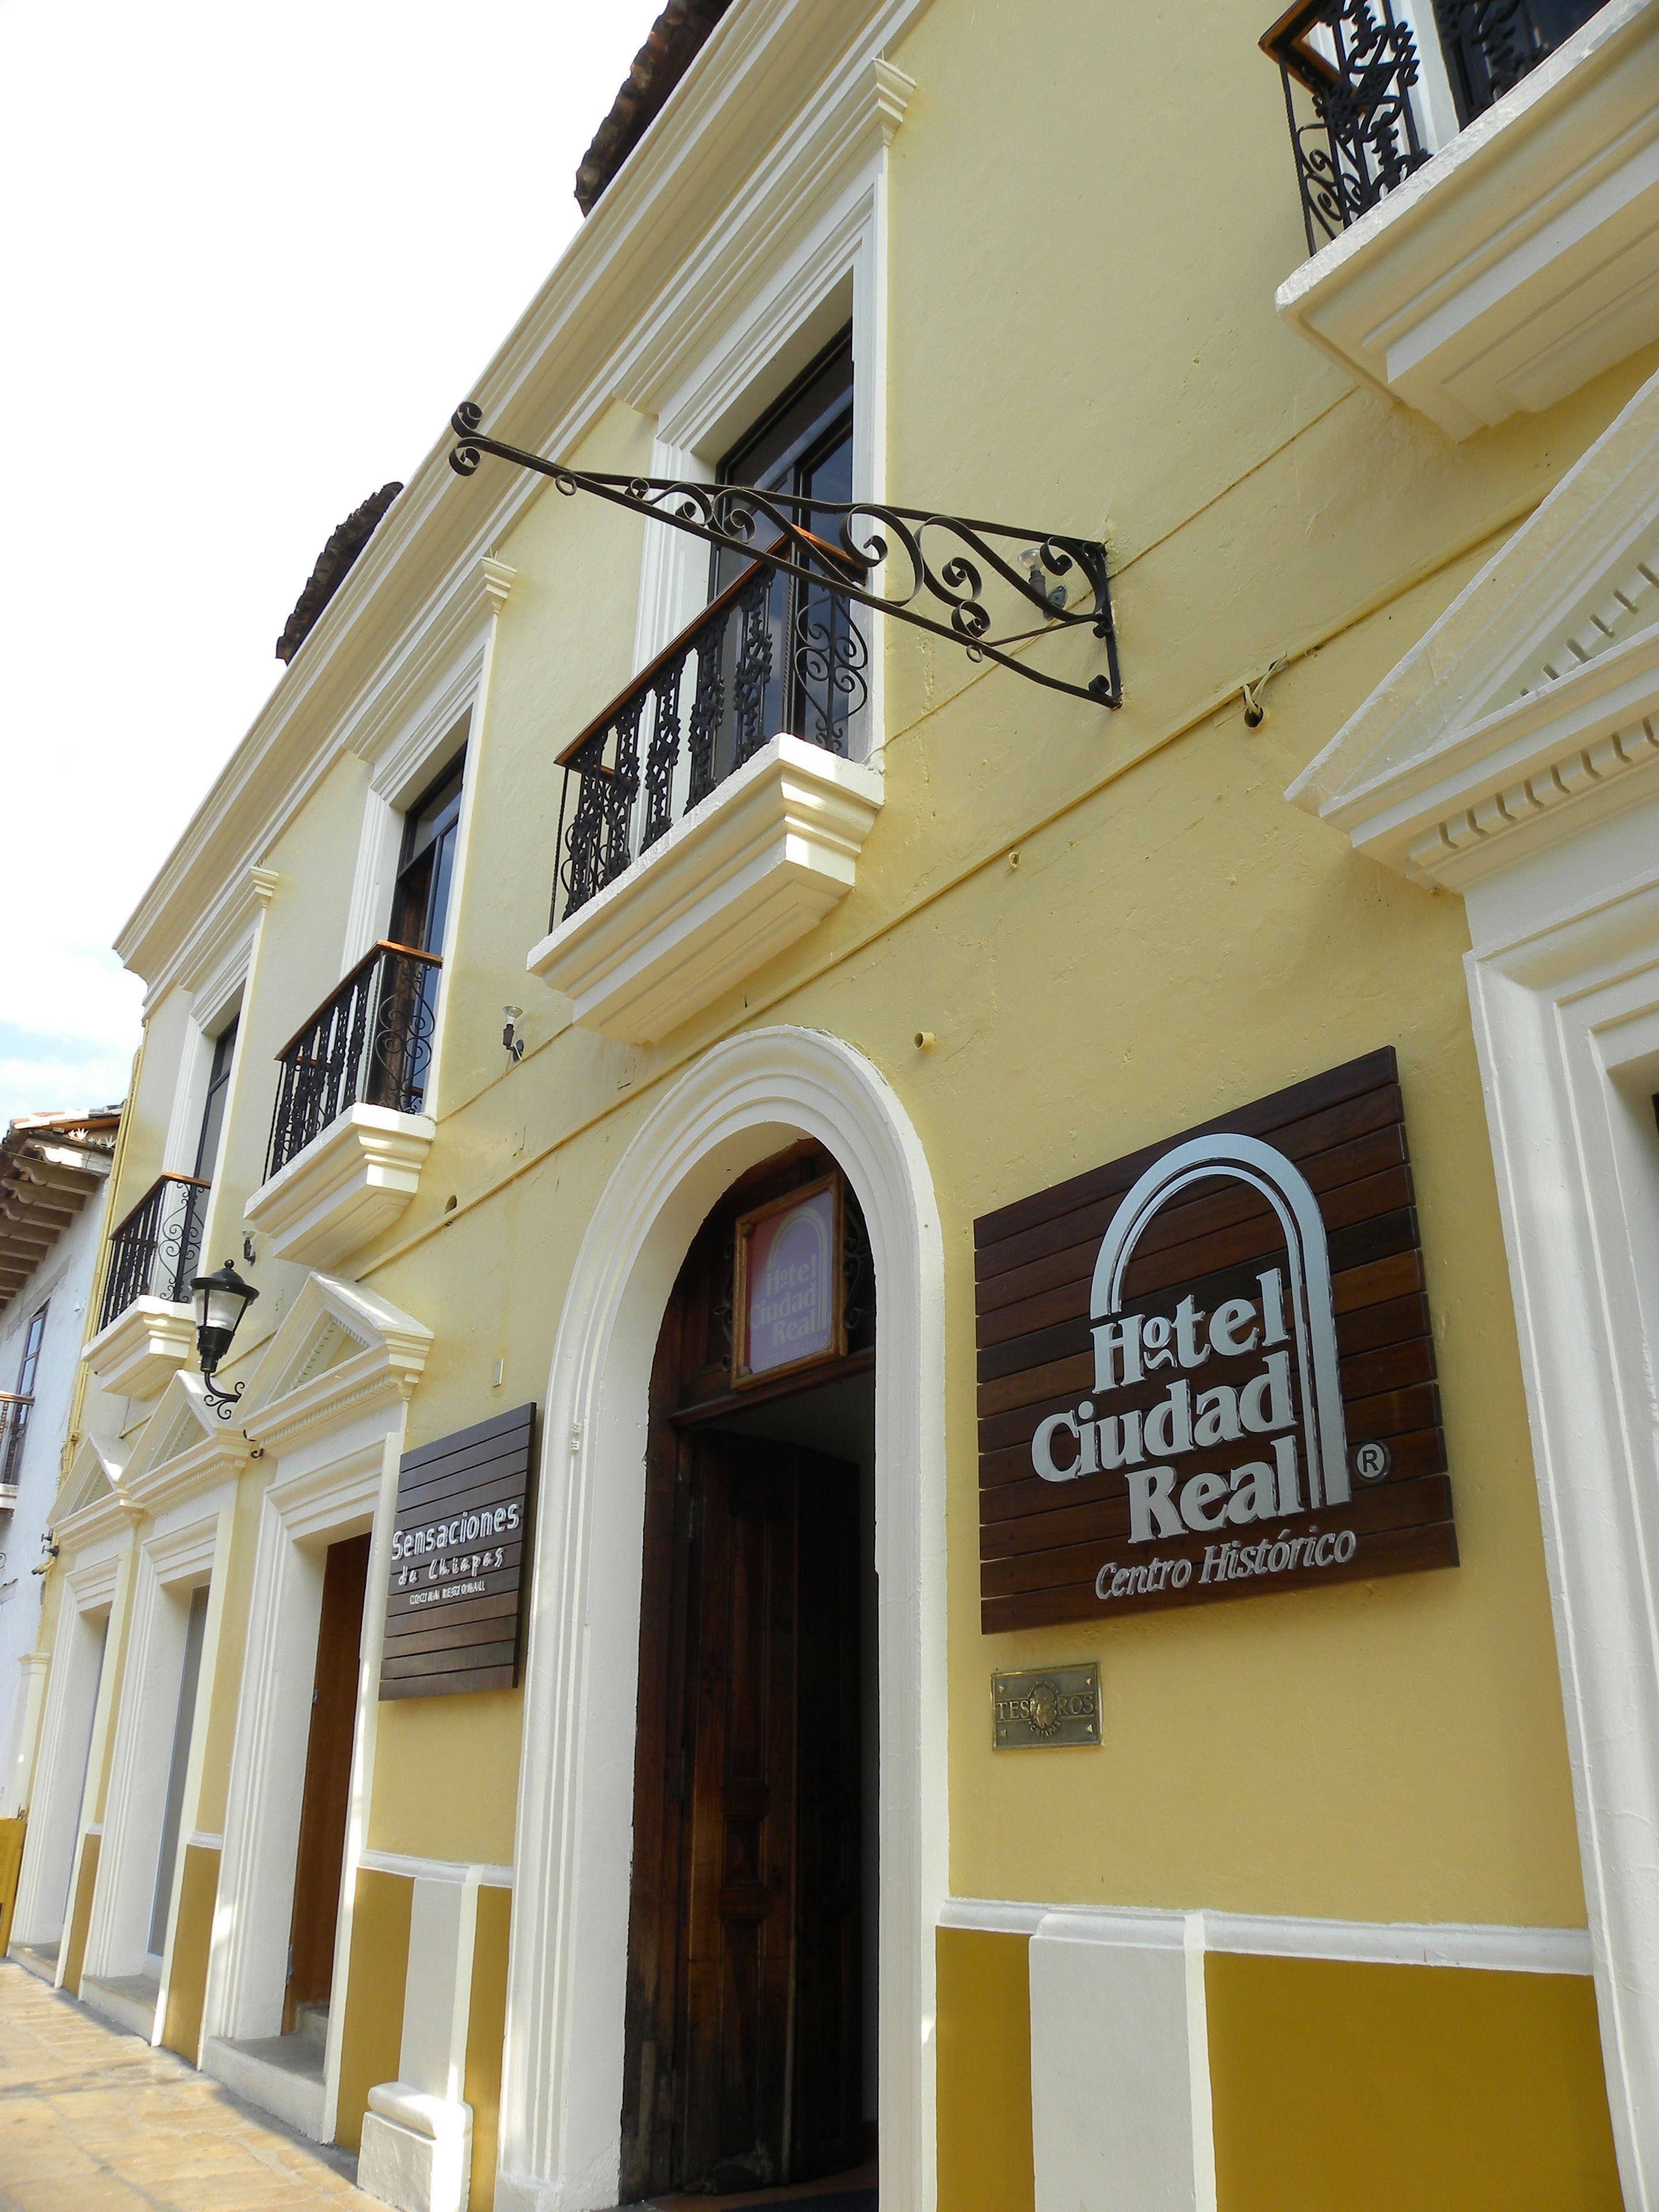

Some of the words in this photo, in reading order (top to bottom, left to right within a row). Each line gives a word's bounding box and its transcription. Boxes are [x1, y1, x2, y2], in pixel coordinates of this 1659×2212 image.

[766, 1254, 817, 1296] Hotel
[773, 1308, 816, 1346] Real
[1090, 1268, 1291, 1394] Hotel
[1031, 1350, 1299, 1483] Ciudad
[1124, 1435, 1305, 1544] Real
[391, 1503, 519, 1560] Sensaciones
[1096, 1557, 1192, 1600] Centro
[1198, 1525, 1357, 1584] Histórico
[398, 1565, 418, 1585] de
